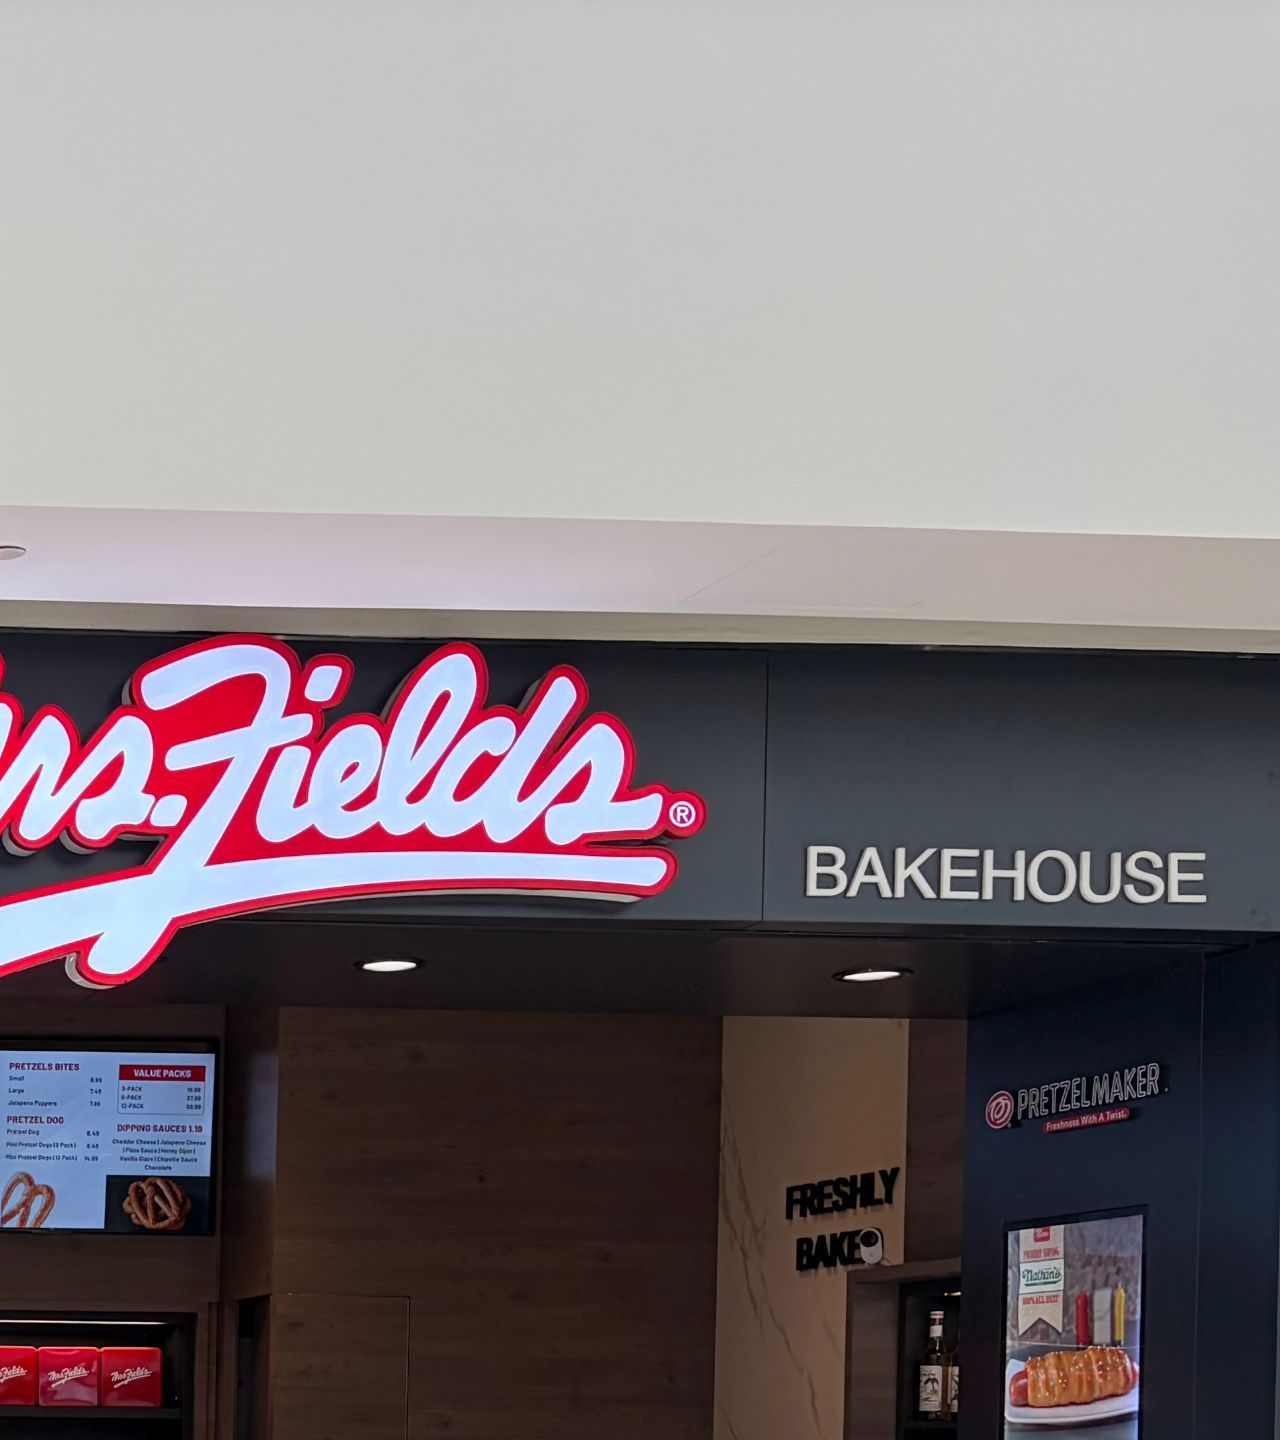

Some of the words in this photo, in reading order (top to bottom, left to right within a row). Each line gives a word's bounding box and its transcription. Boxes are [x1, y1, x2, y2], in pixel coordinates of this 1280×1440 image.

[805, 846, 1208, 905] BAKEHOUSE
[9, 1062, 53, 1071] PRETZELS
[54, 1062, 80, 1071] BITES
[133, 1068, 162, 1078] VALUE
[163, 1069, 192, 1078] PACKS
[1016, 1062, 1160, 1120] PRETZELMAKER
[7, 1115, 45, 1124] PRETZEL
[46, 1116, 64, 1124] DOG
[117, 1123, 151, 1133] DIPPING
[153, 1124, 187, 1133] SAUCES
[1046, 1117, 1080, 1131] Freshness
[1080, 1114, 1098, 1127] With
[786, 1167, 900, 1220] FRESHLY
[796, 1228, 881, 1271] BAKE
